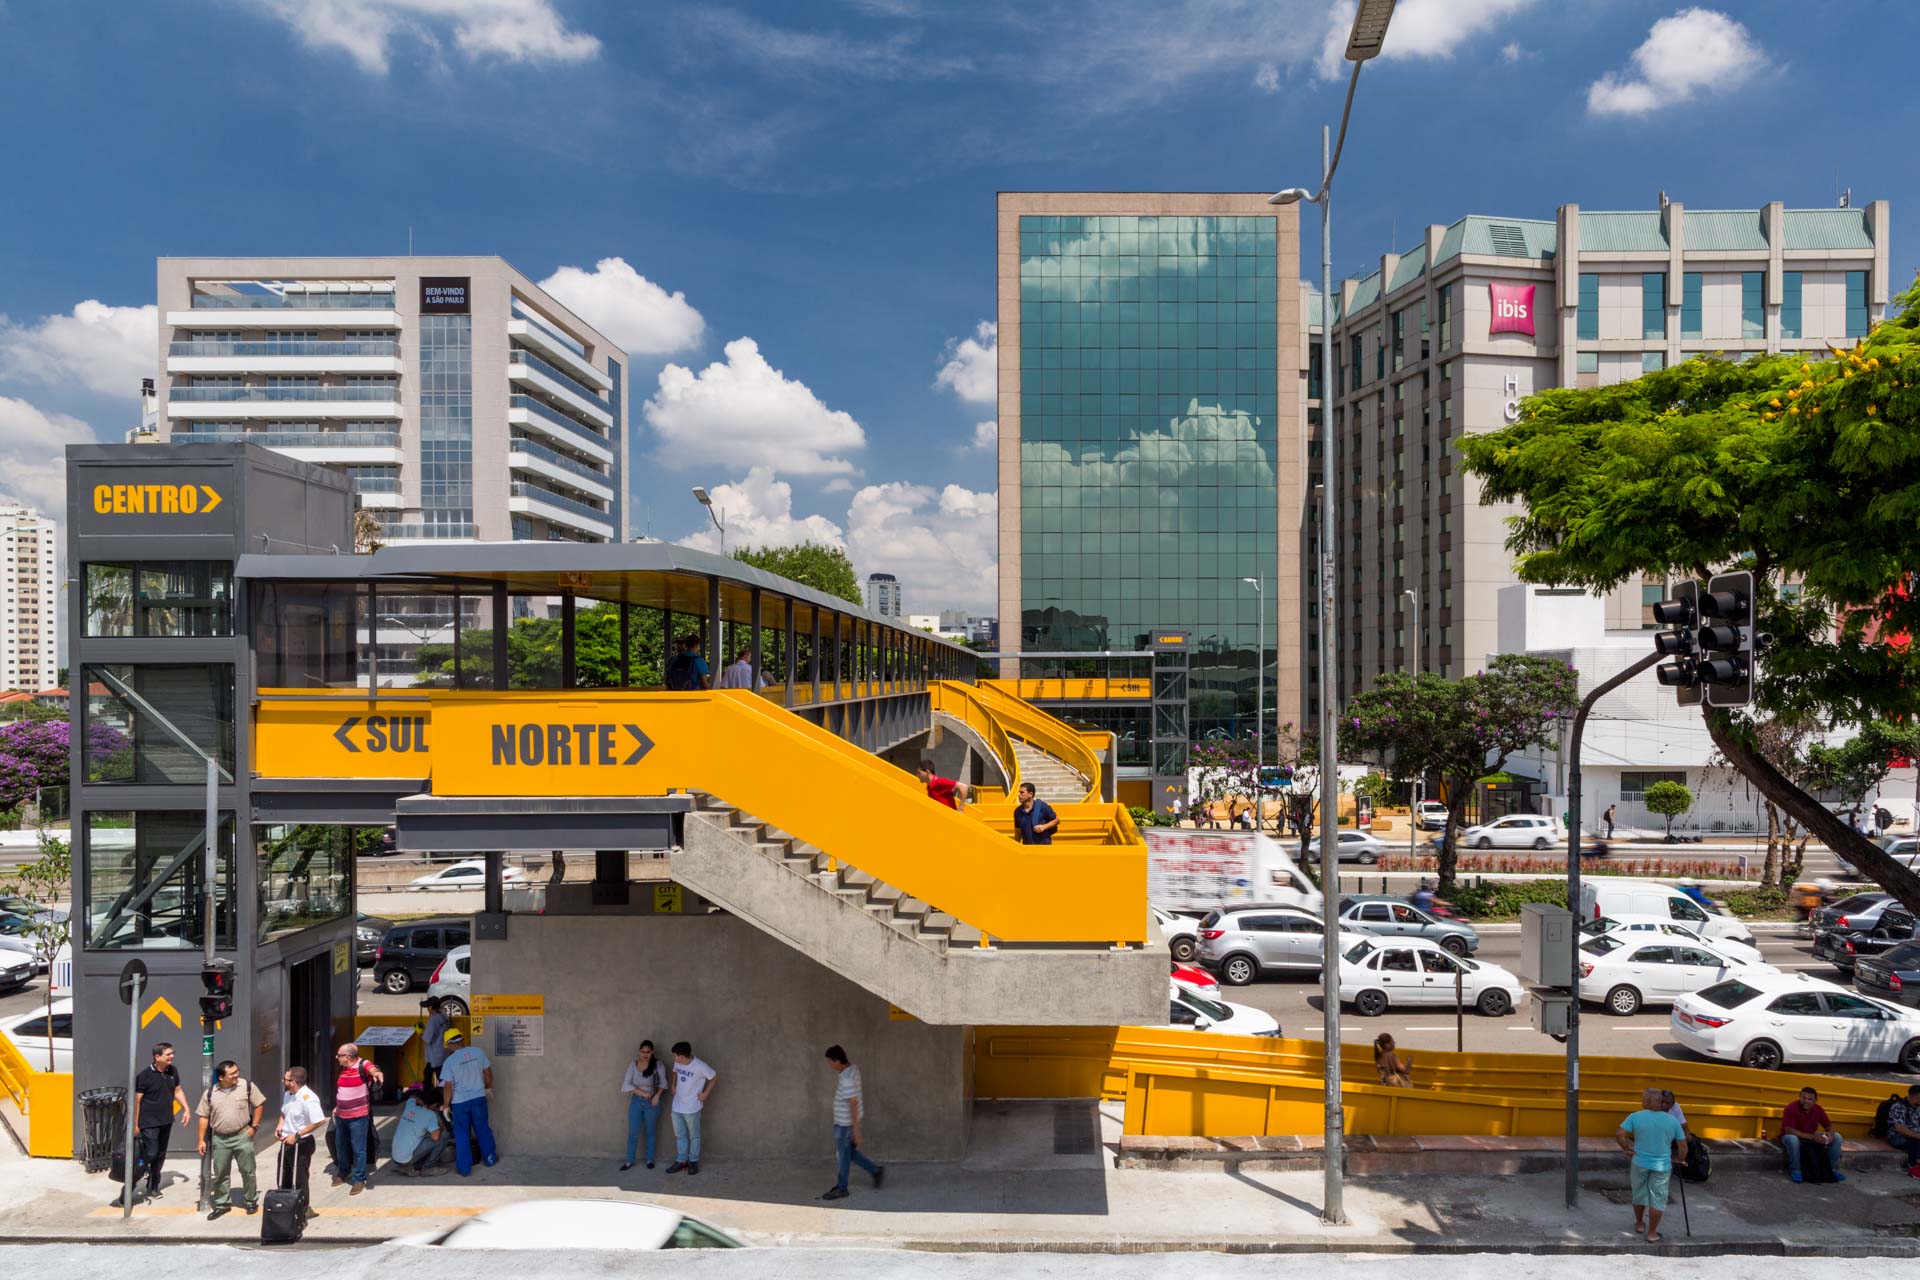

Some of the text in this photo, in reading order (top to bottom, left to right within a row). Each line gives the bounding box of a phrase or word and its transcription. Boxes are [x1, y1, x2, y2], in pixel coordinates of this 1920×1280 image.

[425, 287, 465, 296] BEM-VINDO
[431, 295, 445, 304] SÃO
[445, 296, 465, 304] PAULO
[1497, 298, 1528, 319] ibis
[93, 484, 198, 514] CENTRO
[366, 715, 430, 753] SUL
[491, 723, 618, 766] NORTE
[658, 886, 678, 894] CITY
